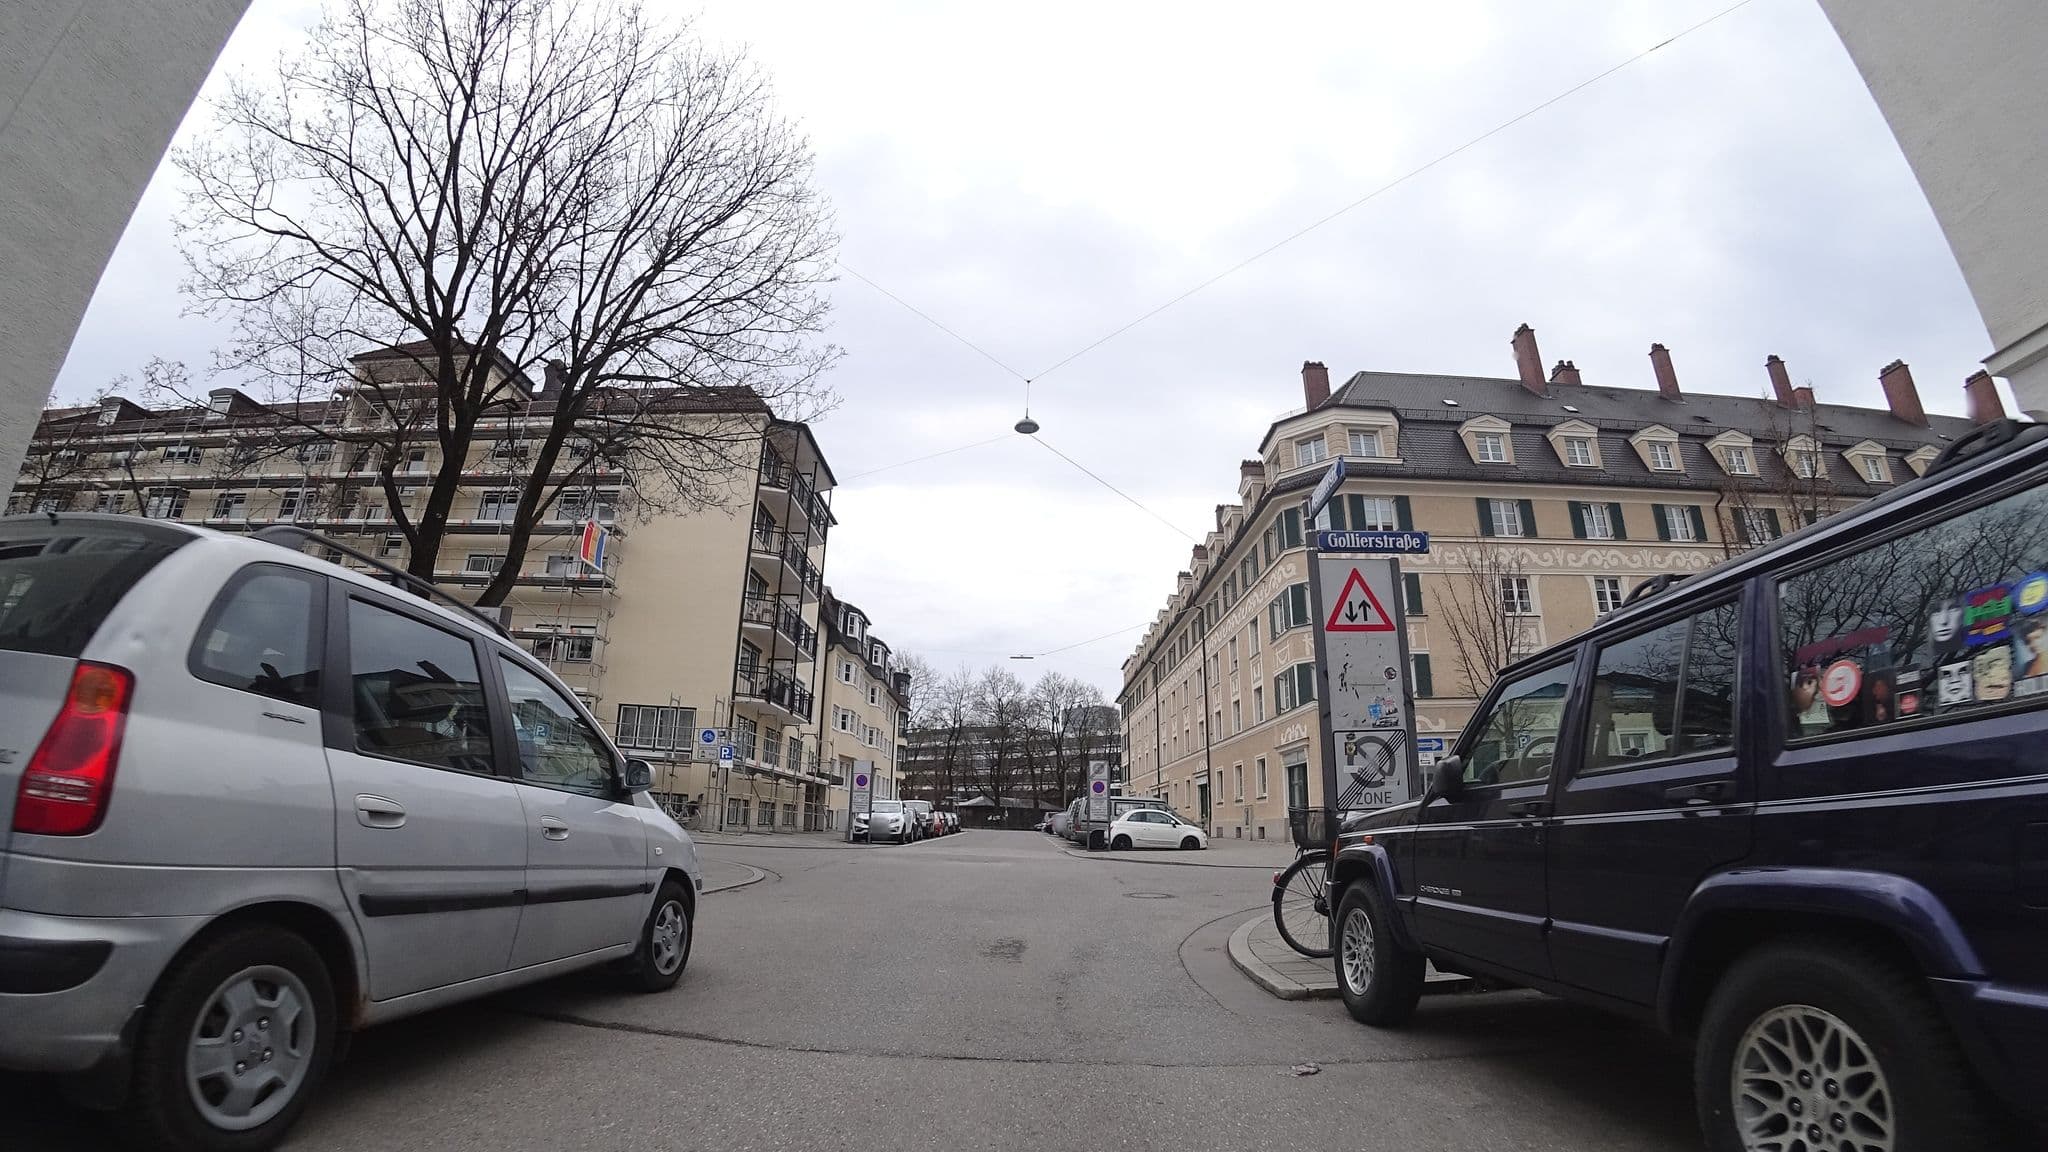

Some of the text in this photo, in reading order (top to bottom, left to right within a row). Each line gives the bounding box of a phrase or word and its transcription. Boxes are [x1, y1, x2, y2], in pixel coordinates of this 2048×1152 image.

[1327, 533, 1421, 551] Gollierstraße
[721, 747, 729, 758] P
[1356, 792, 1392, 805] ZONE
